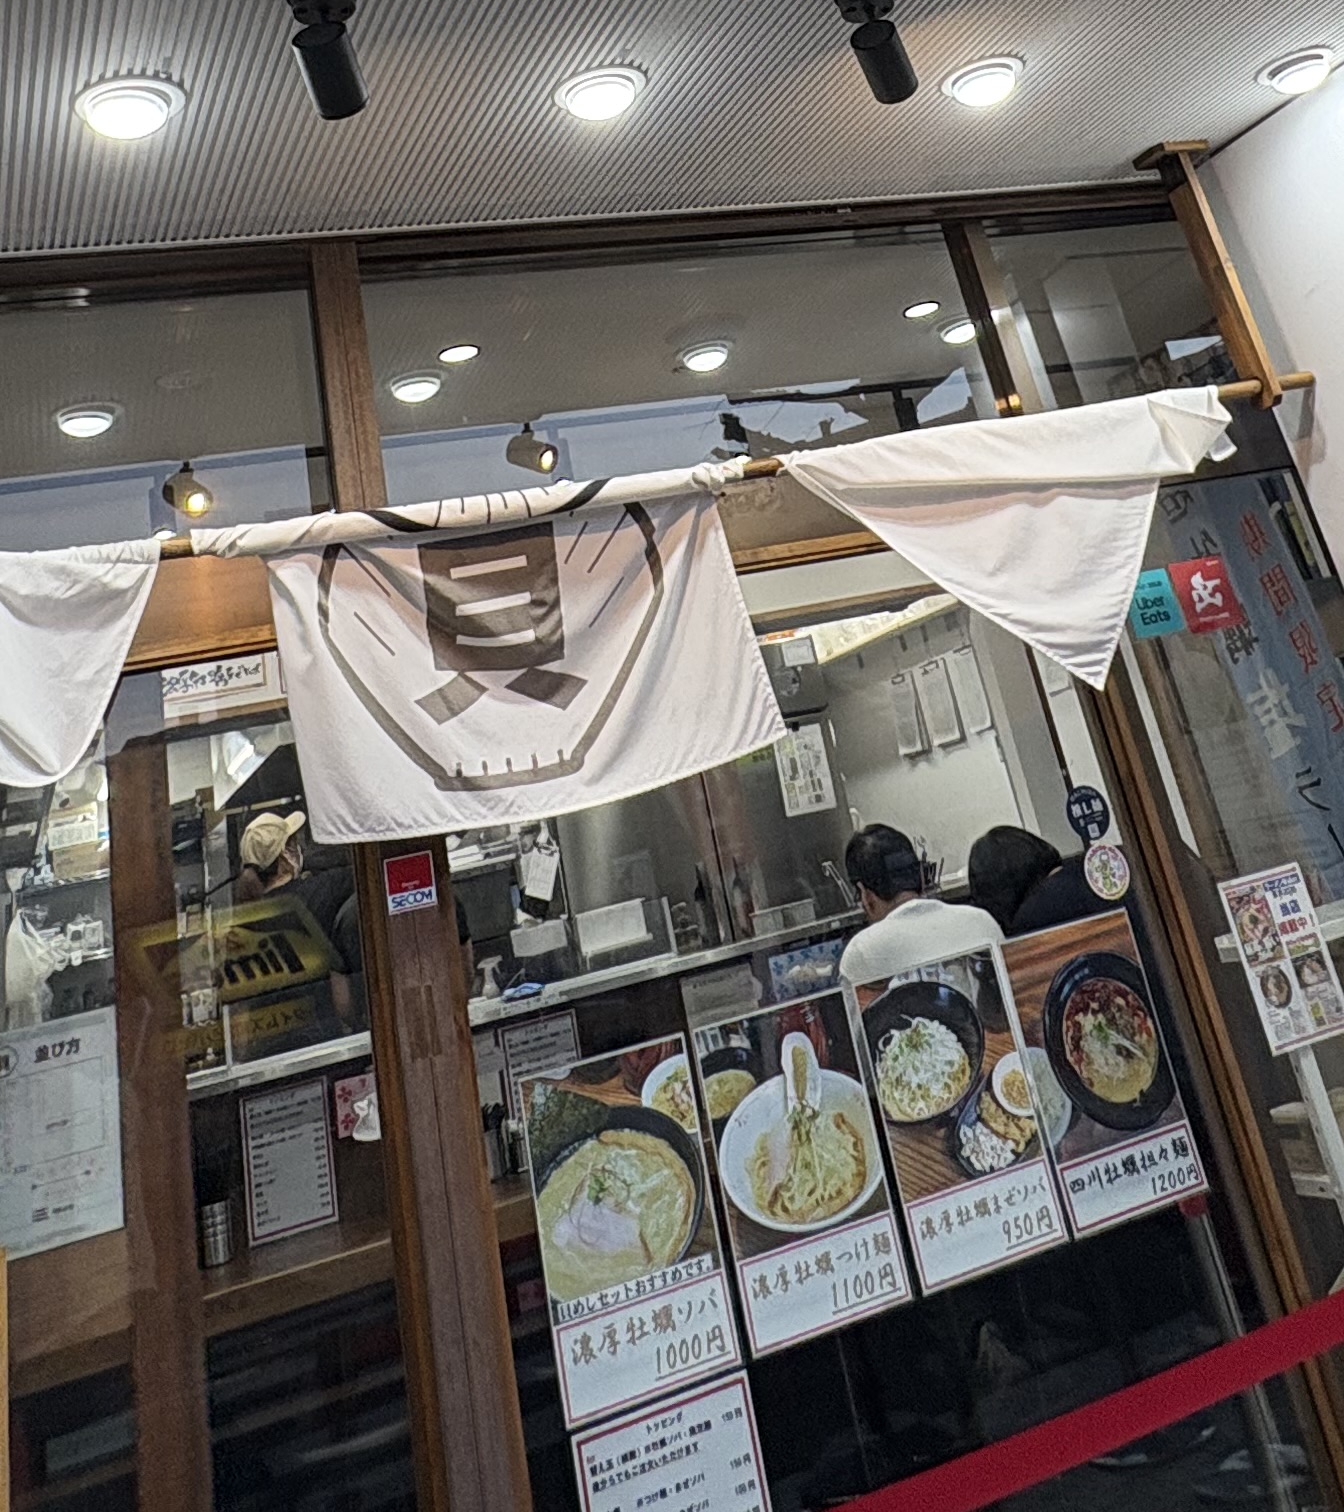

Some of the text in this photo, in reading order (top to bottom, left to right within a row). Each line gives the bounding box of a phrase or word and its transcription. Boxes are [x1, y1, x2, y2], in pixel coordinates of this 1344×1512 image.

[1135, 594, 1165, 611] Uber
[1140, 609, 1172, 626] Eats
[390, 888, 433, 909] SECOM
[1150, 1163, 1201, 1197] 1200円
[1001, 1204, 1054, 1245] 950円
[751, 1231, 891, 1301] 濃厚牡蠣つけ麺
[831, 1262, 898, 1309] 1100円
[571, 1288, 718, 1367] 濃厚牡蠣ソバ
[656, 1324, 726, 1374] 1000円
